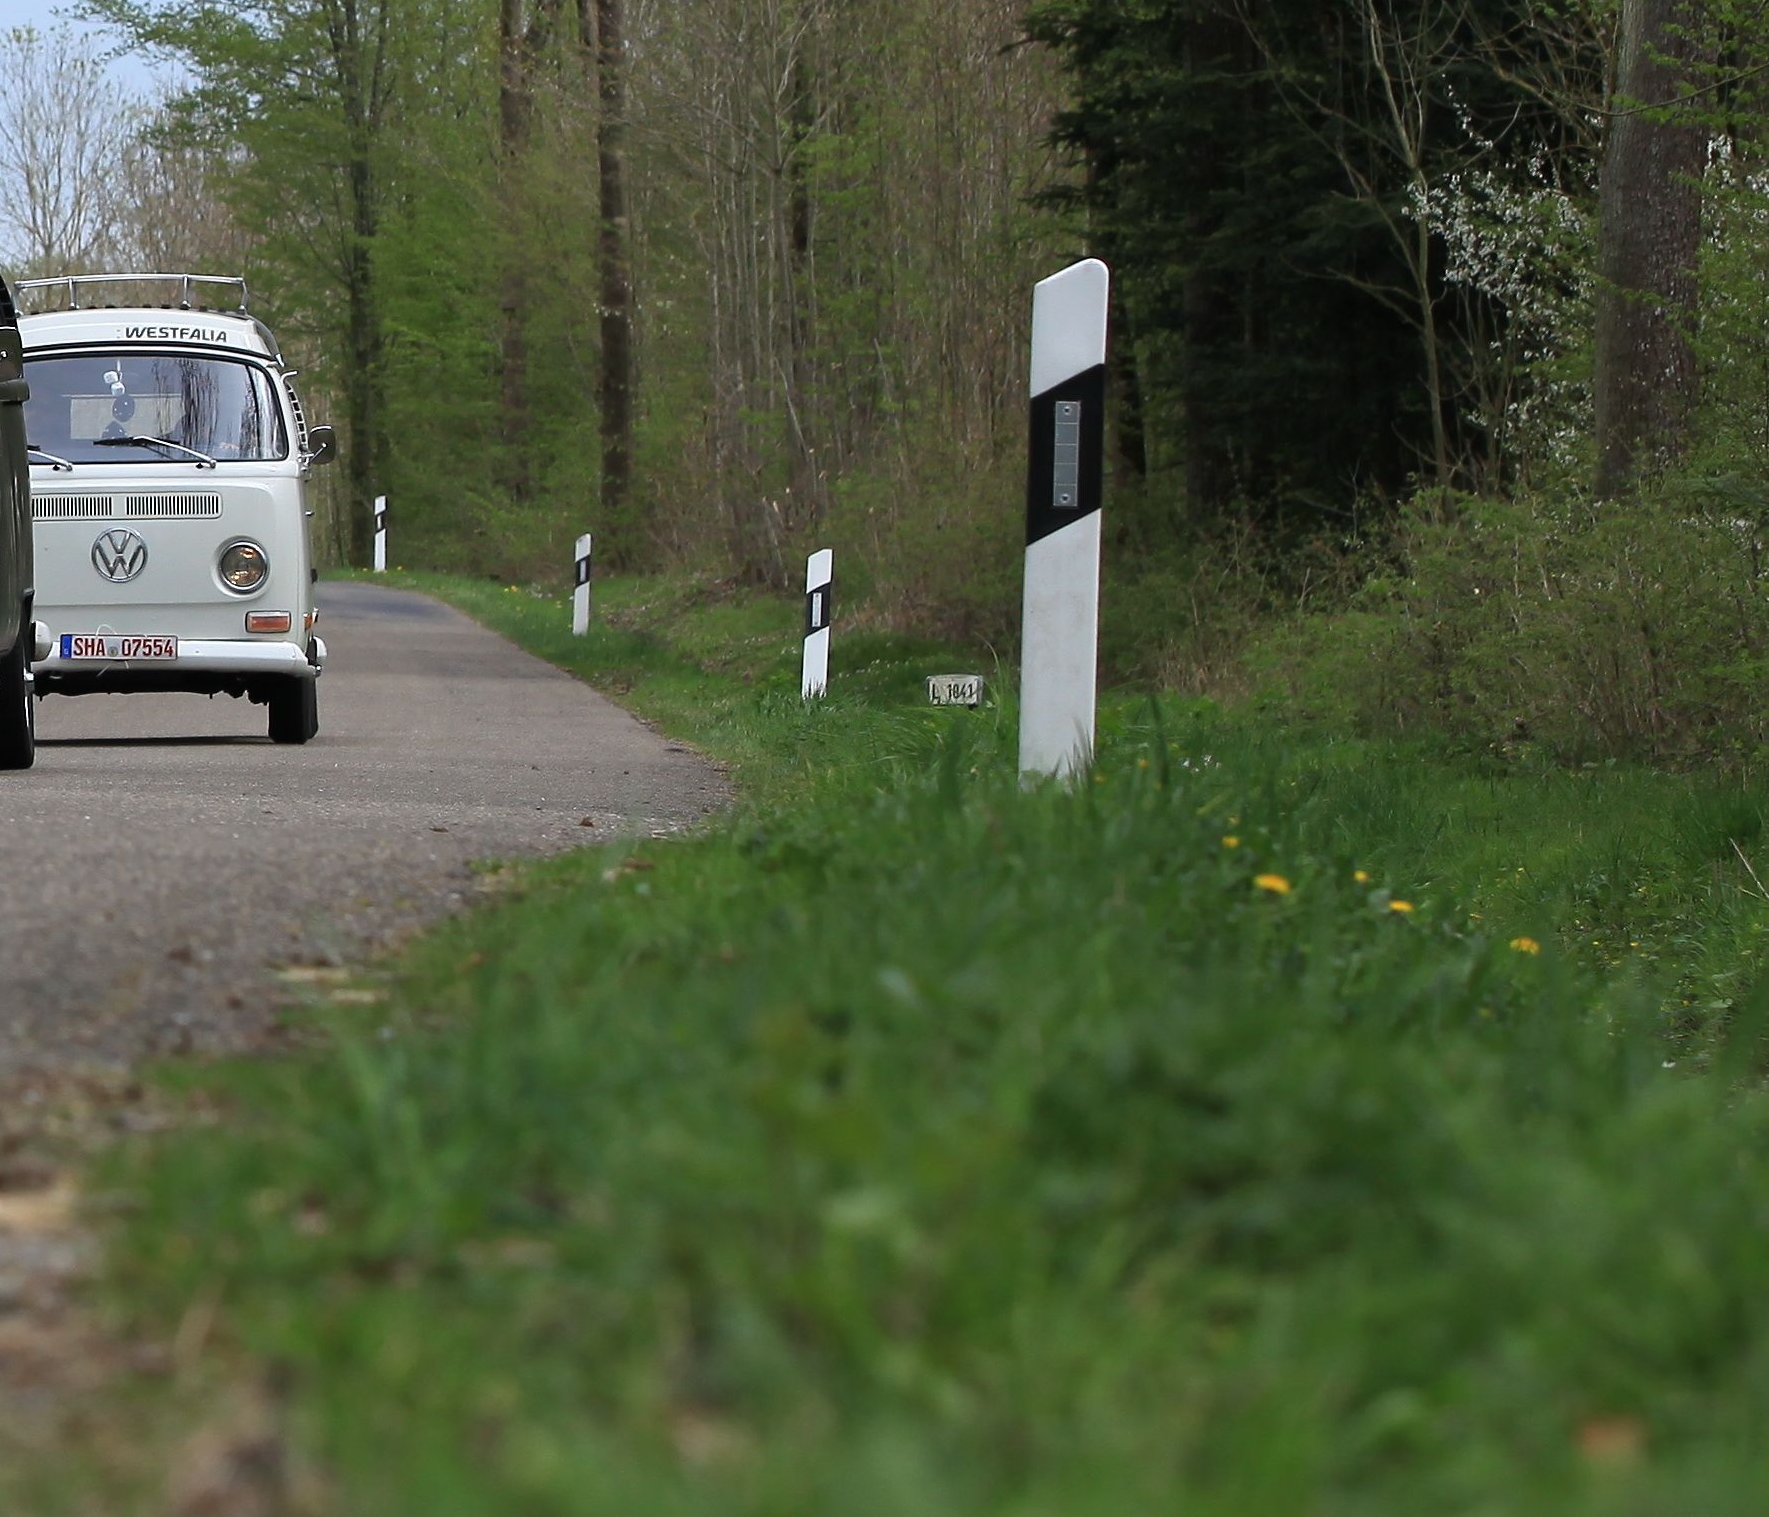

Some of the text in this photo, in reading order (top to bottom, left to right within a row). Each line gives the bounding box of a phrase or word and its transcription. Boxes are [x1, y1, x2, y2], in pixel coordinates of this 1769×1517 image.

[125, 326, 228, 343] WESTFALIA
[94, 529, 145, 581] VW
[74, 637, 174, 658] SHA 07554
